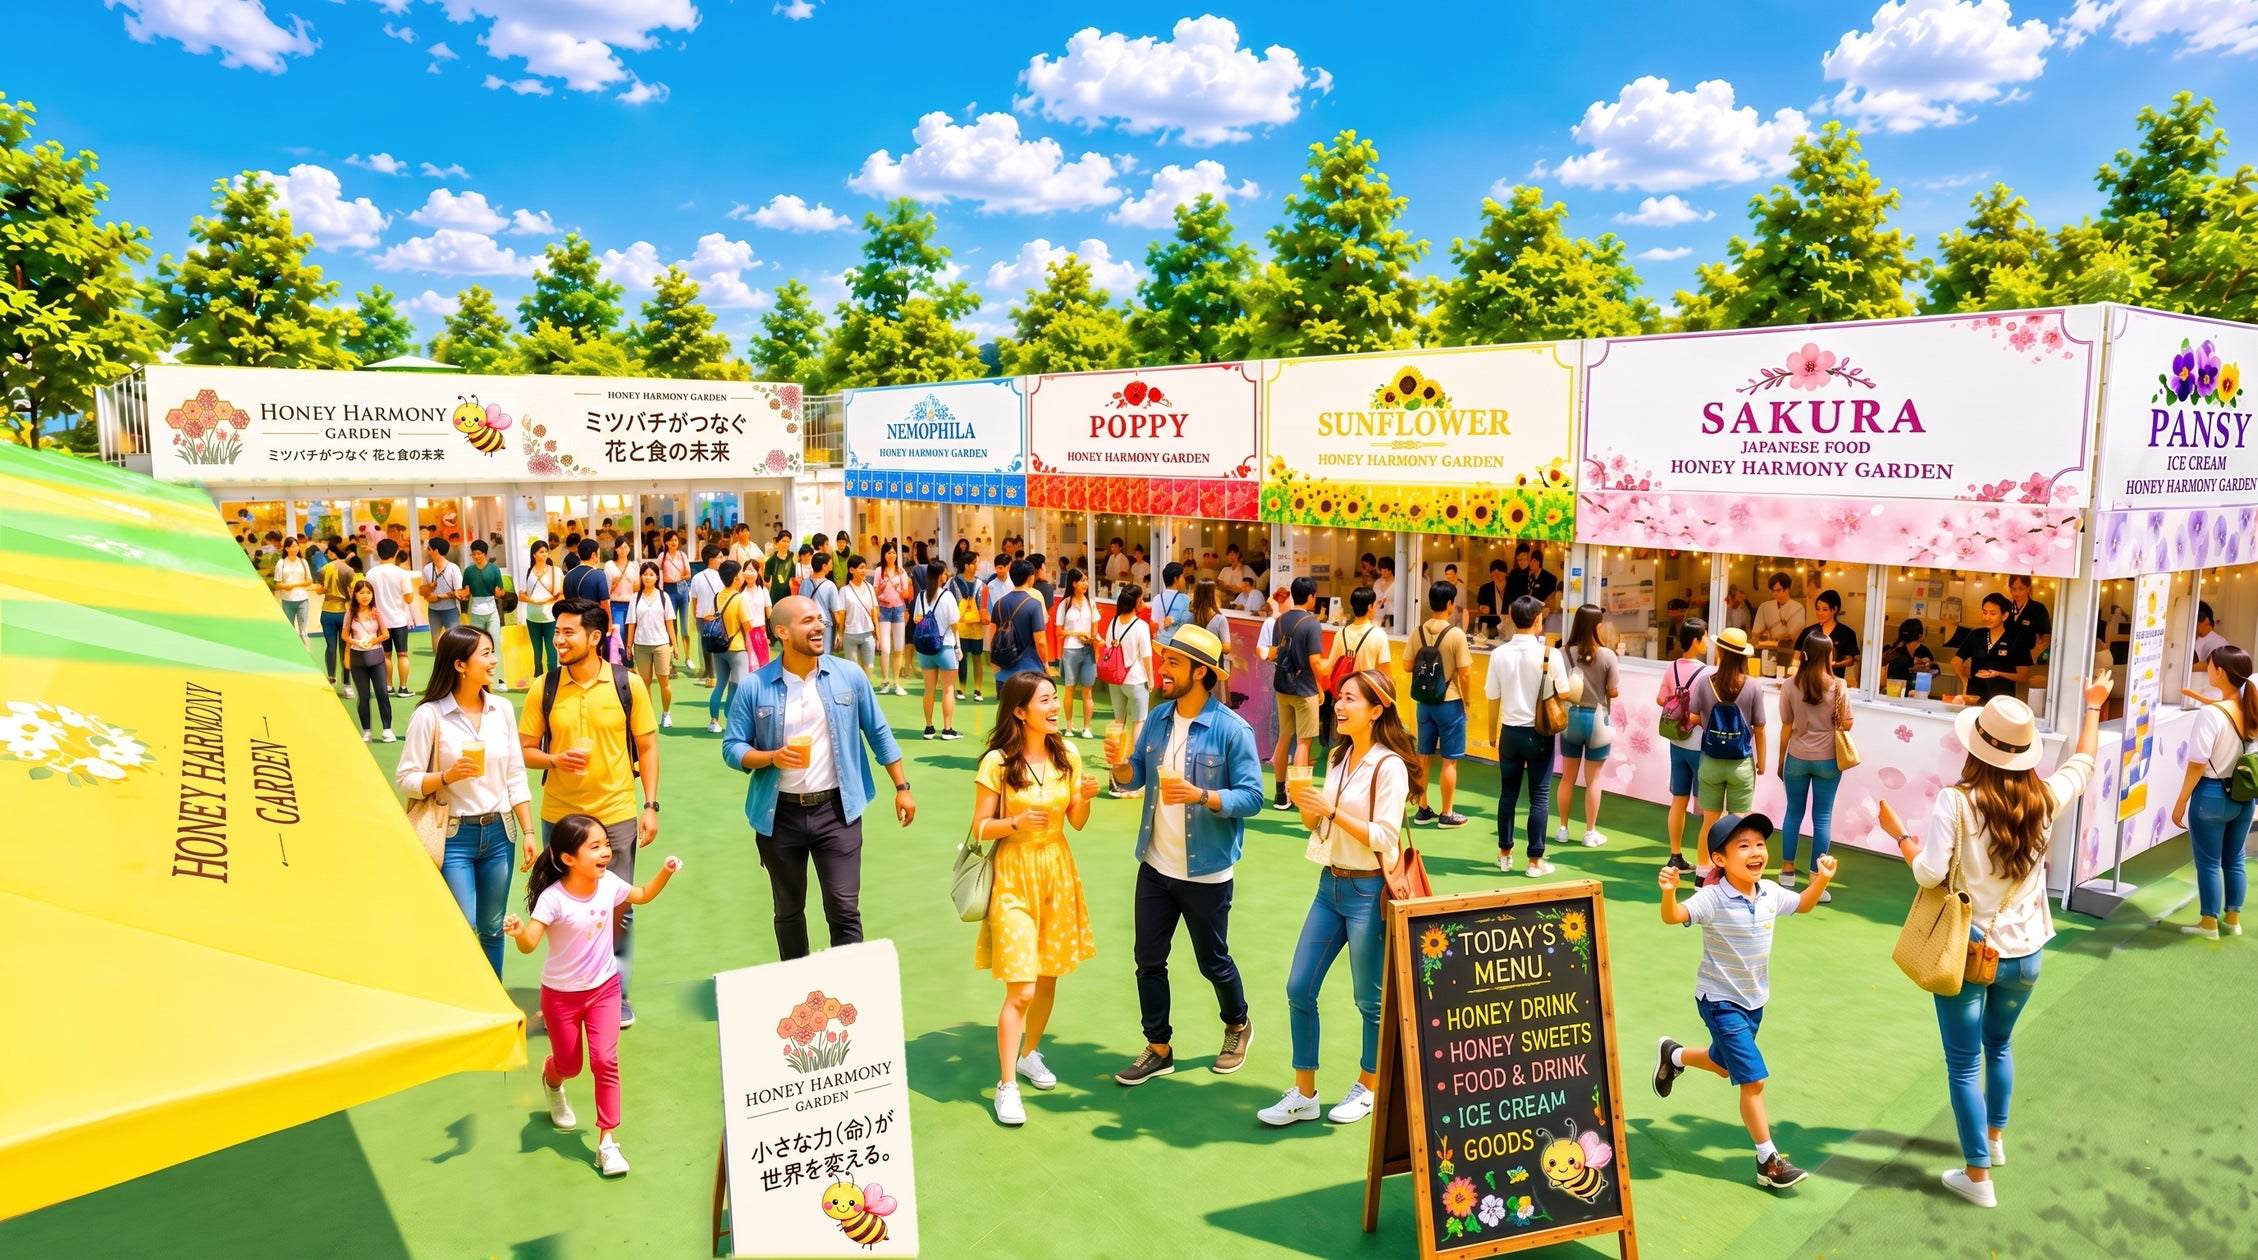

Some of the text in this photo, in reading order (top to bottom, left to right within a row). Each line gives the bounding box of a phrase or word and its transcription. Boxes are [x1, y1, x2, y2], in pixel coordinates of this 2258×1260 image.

[608, 391, 727, 402] HONEY HARMONY GARDEN
[261, 403, 447, 423] HONEY HARMONY
[586, 411, 746, 435] ミツバチがつなぐ
[1318, 409, 1511, 436] SUNFLOWER
[1701, 398, 1926, 434] SAKURA
[325, 428, 391, 439] GARDEN
[887, 421, 976, 440] NEMOPHILA
[1089, 413, 1189, 438] POPPY
[2147, 408, 2253, 449] PANSY
[268, 449, 445, 461] ミツバチがつなぐ 花と食の未来
[605, 439, 730, 463] 花と食の未来
[880, 448, 988, 459] HONEY HARMONY GARDEN
[1067, 451, 1210, 464] HONEY HARMONY GARDEN
[1740, 440, 1871, 455] JAPANESE FOOD
[1318, 454, 1504, 468] HONEY HARMONY GARDEN
[1670, 459, 1954, 480] HONEY HARMONY GARDEN
[2167, 455, 2227, 470] ICE CREAM
[2125, 477, 2257, 495] HONEY HARMONY GARDEN
[172, 681, 228, 883] HONEY HARMONY
[250, 739, 300, 825] GARDEN
[1457, 922, 1557, 956] TODAY'S
[1447, 992, 1579, 1031] HONEY DRINK
[1450, 1022, 1592, 1063] HONEY SWEETS
[745, 1061, 893, 1107] HONEY HARMONY
[1453, 1054, 1588, 1096] FOOD & DRINK
[795, 1090, 850, 1112] GARDEN
[1458, 1090, 1566, 1129] ICE CREAM
[1464, 1129, 1535, 1162] GOODS
[760, 1144, 890, 1192] 世界を変える。
